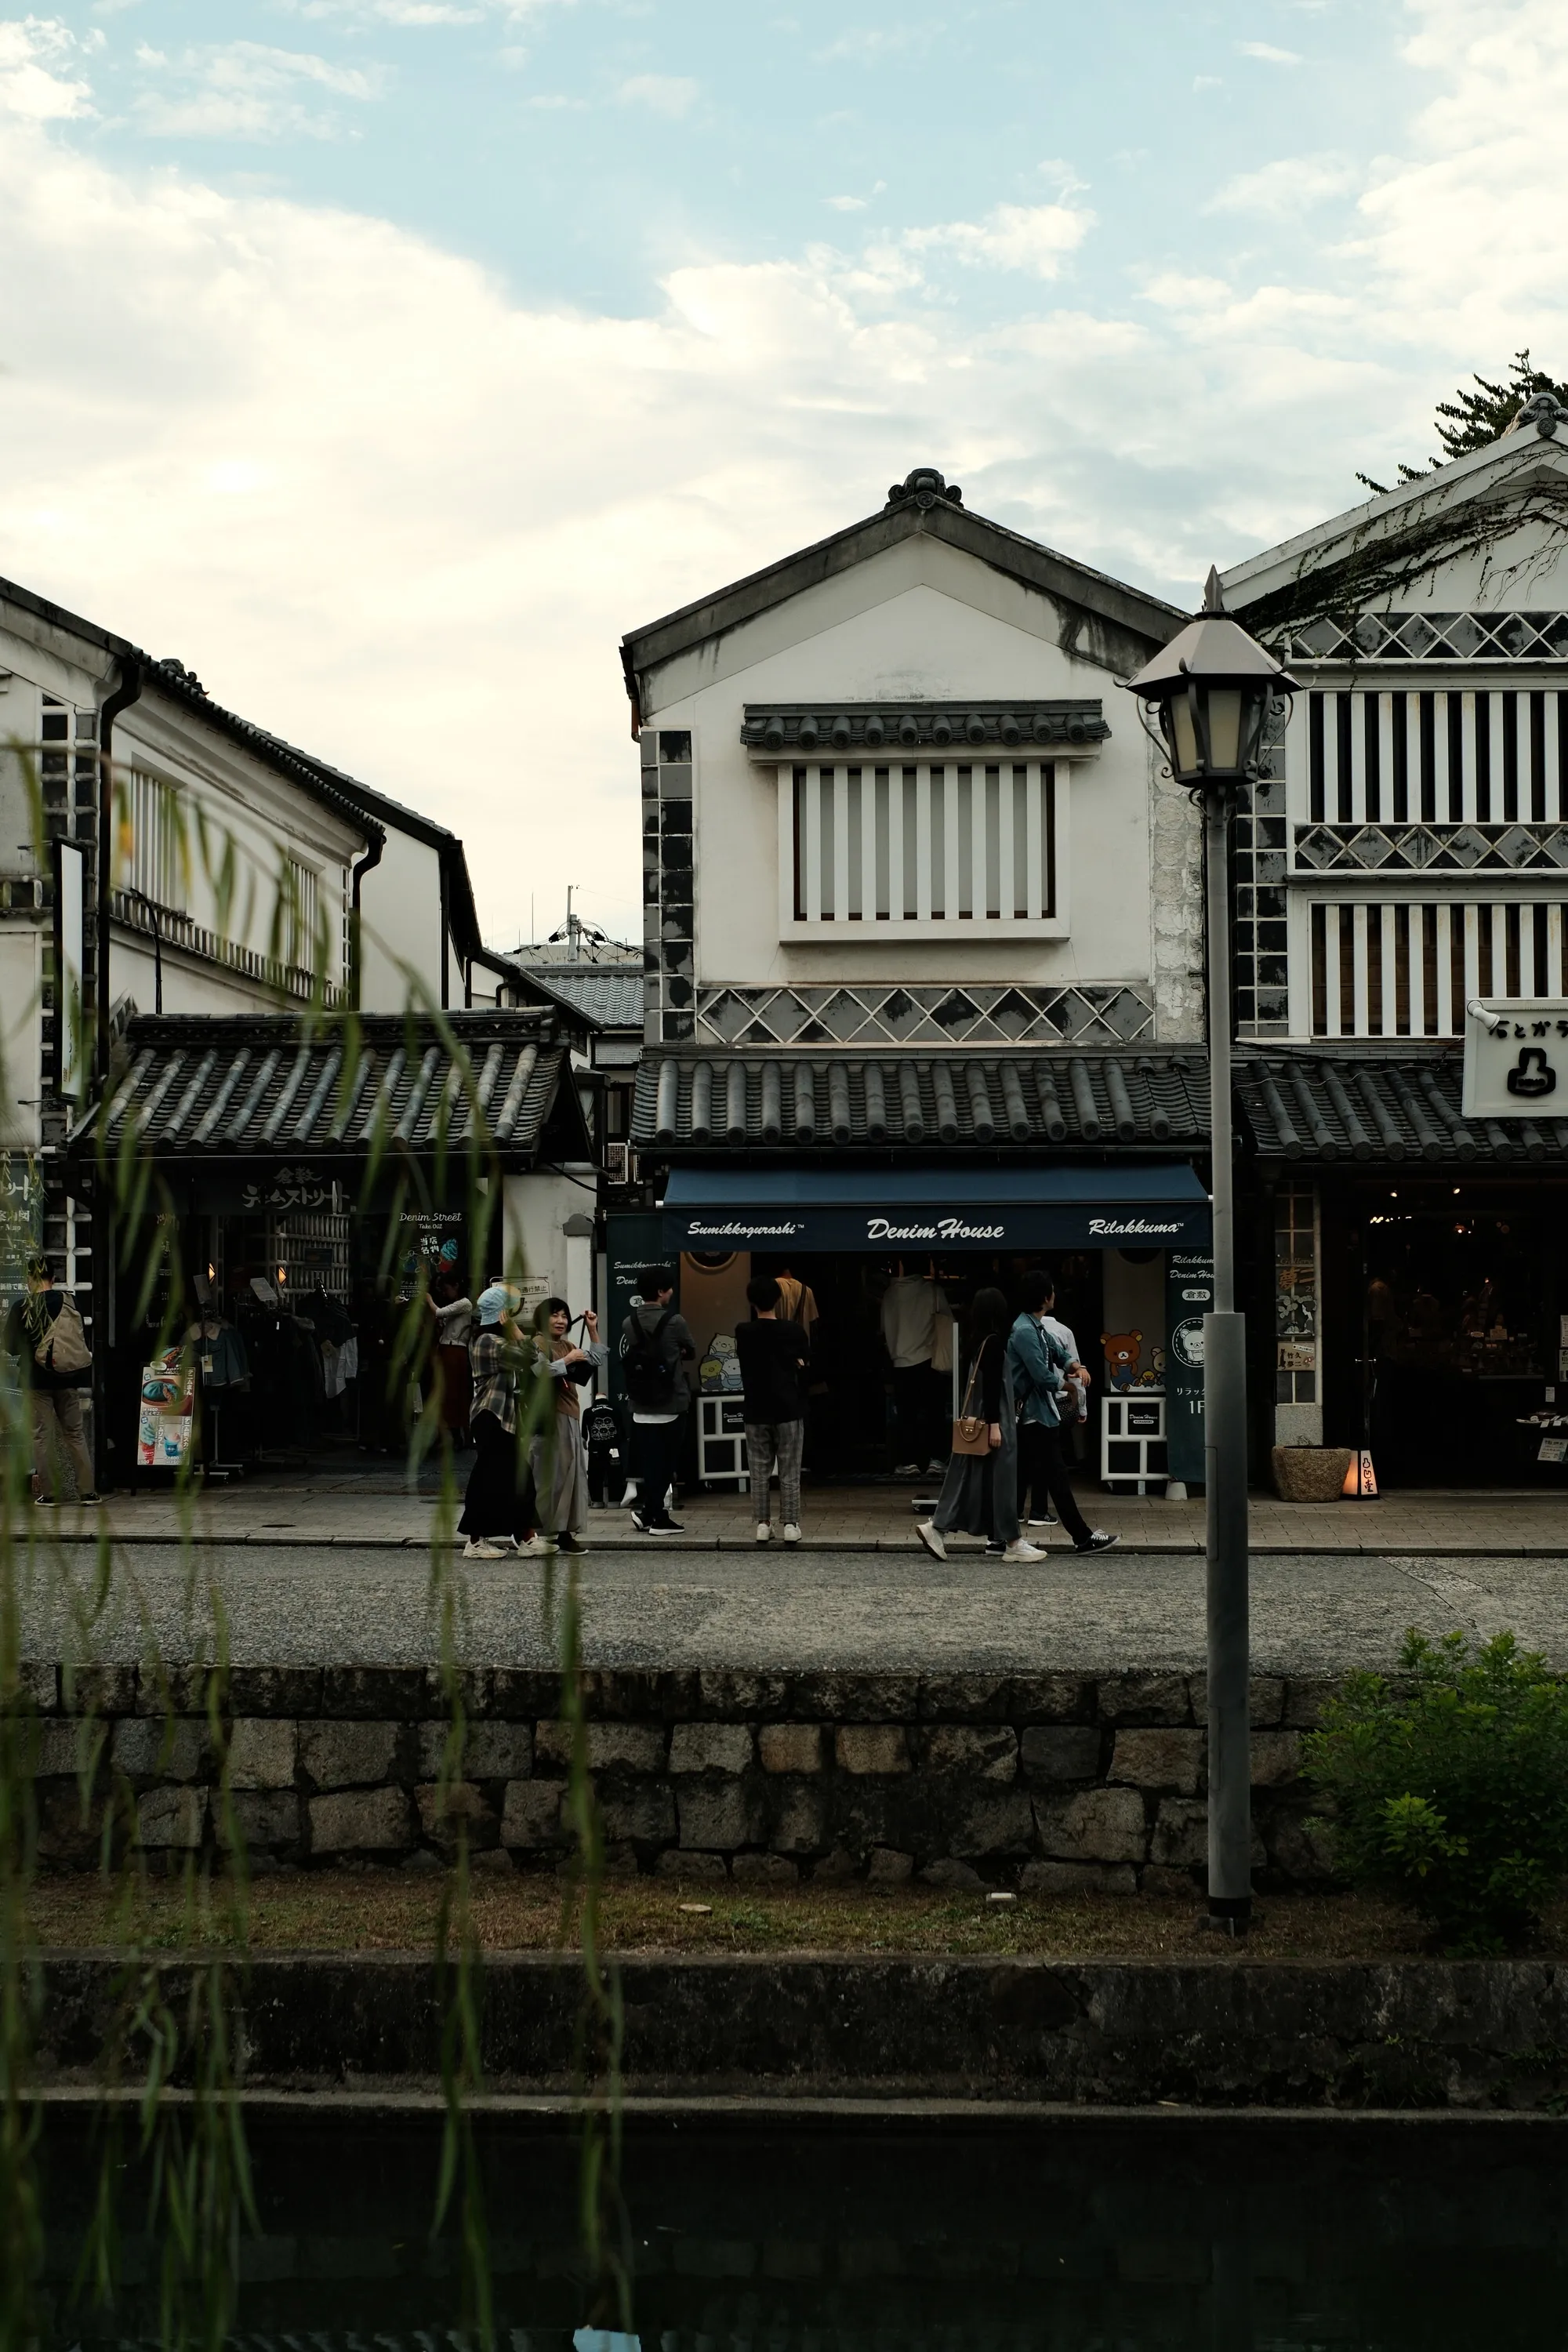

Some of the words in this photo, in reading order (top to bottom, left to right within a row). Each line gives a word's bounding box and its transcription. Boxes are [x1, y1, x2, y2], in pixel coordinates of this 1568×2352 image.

[1489, 1020, 1568, 1039] 石とガラ
[273, 1164, 324, 1185] 倉敷
[399, 1212, 430, 1221] Denim
[432, 1212, 463, 1221] Street
[867, 1218, 938, 1240] Denim
[937, 1218, 1005, 1239] House
[1172, 1254, 1214, 1264] Rilakkum
[1169, 1269, 1197, 1279] Denim
[1197, 1269, 1214, 1279] Hou
[615, 1276, 637, 1285] Deni
[1185, 1290, 1207, 1299] 倉敷
[633, 1297, 644, 1306] 倉
